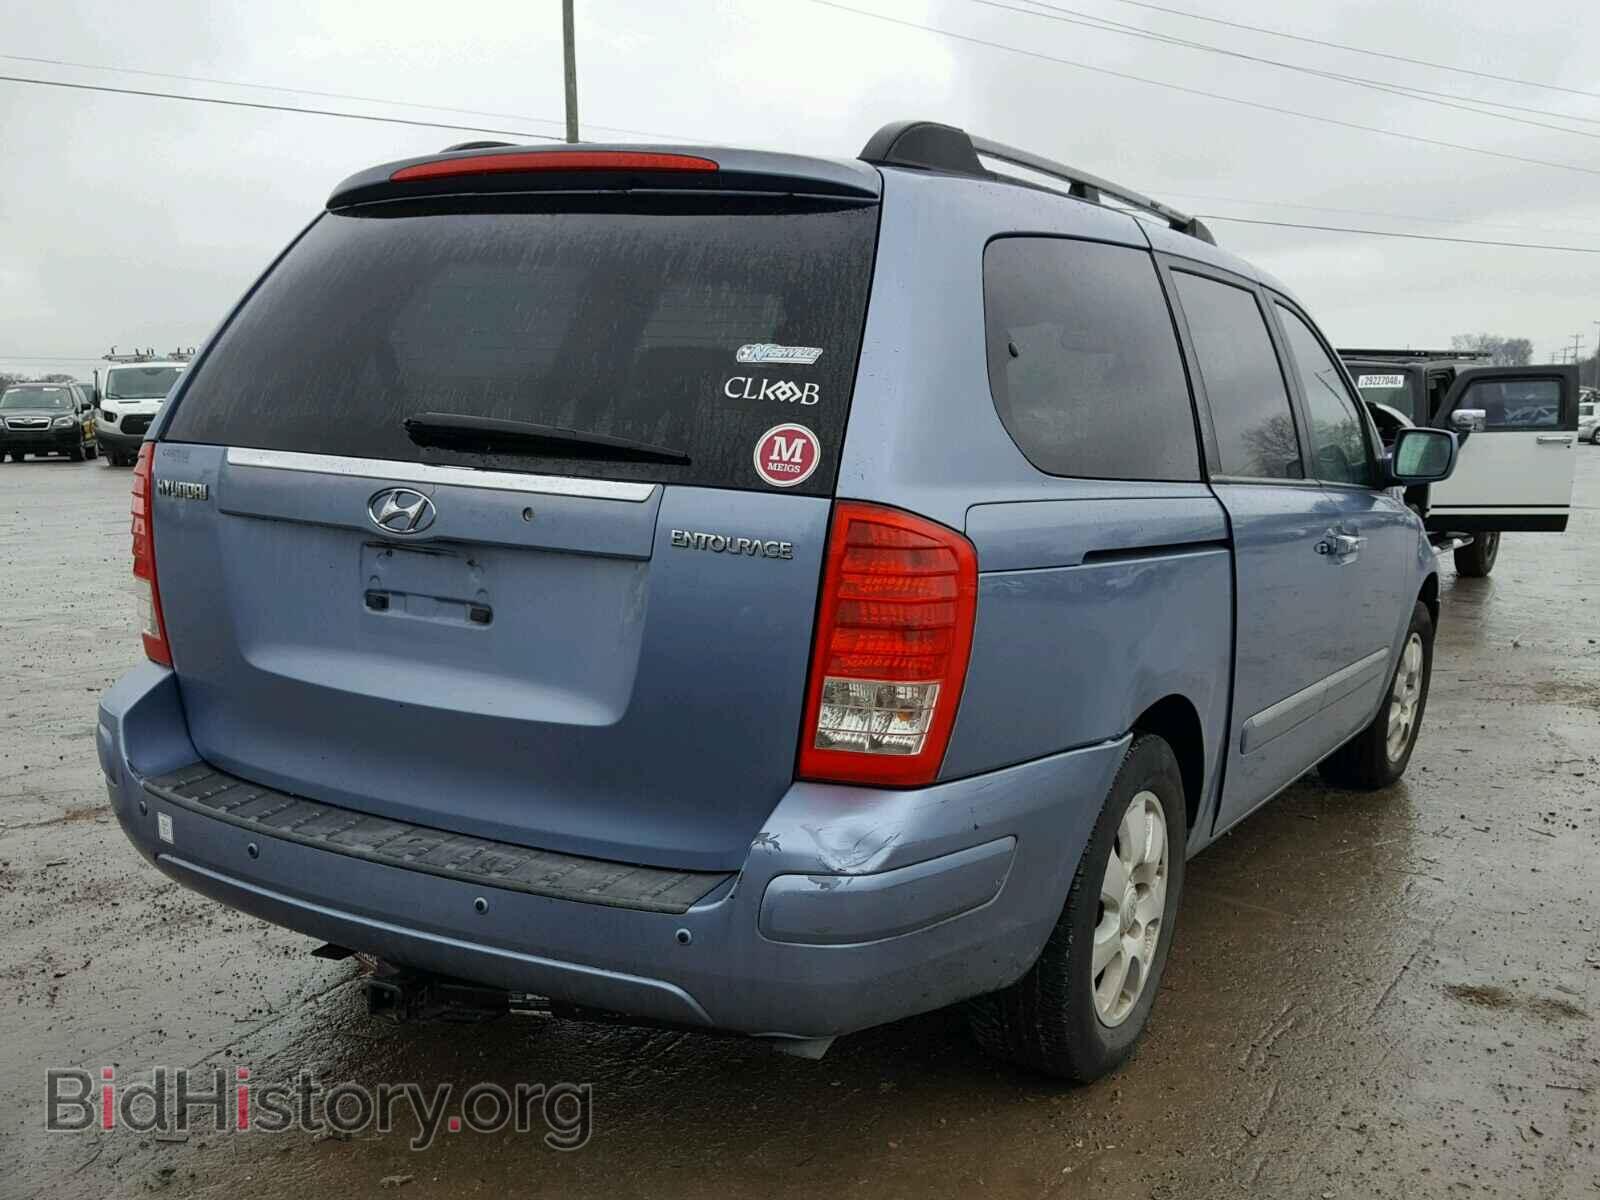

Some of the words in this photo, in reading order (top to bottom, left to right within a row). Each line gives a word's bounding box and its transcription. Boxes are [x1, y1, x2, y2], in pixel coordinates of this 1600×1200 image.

[769, 436, 806, 462] M
[767, 462, 801, 473] MEIGS
[158, 480, 209, 500] HYUNDAI
[671, 529, 793, 559] ENTOURAGE
